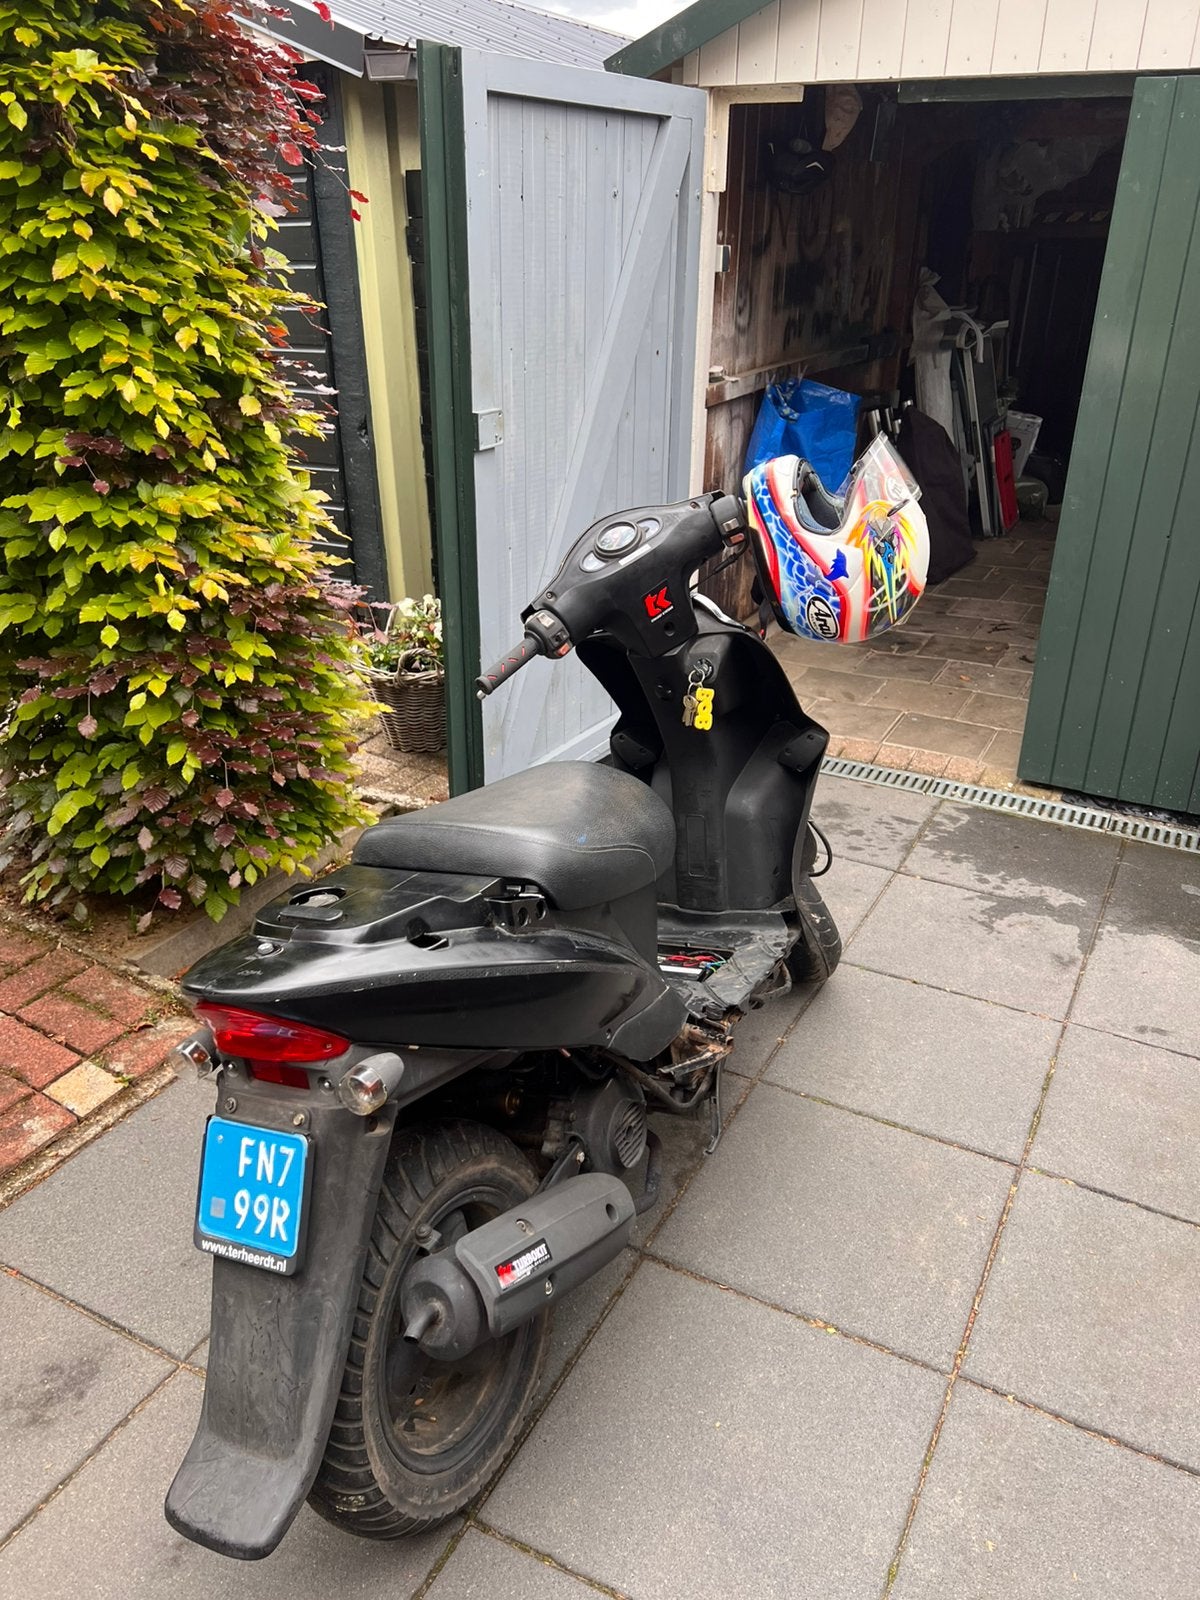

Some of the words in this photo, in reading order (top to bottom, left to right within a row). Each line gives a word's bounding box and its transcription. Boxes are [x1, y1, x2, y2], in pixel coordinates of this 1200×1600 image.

[812, 602, 836, 636] Arai
[238, 1135, 296, 1188] FN7
[233, 1188, 291, 1242] 99R
[201, 1239, 287, 1273] www.terheerdt.nl
